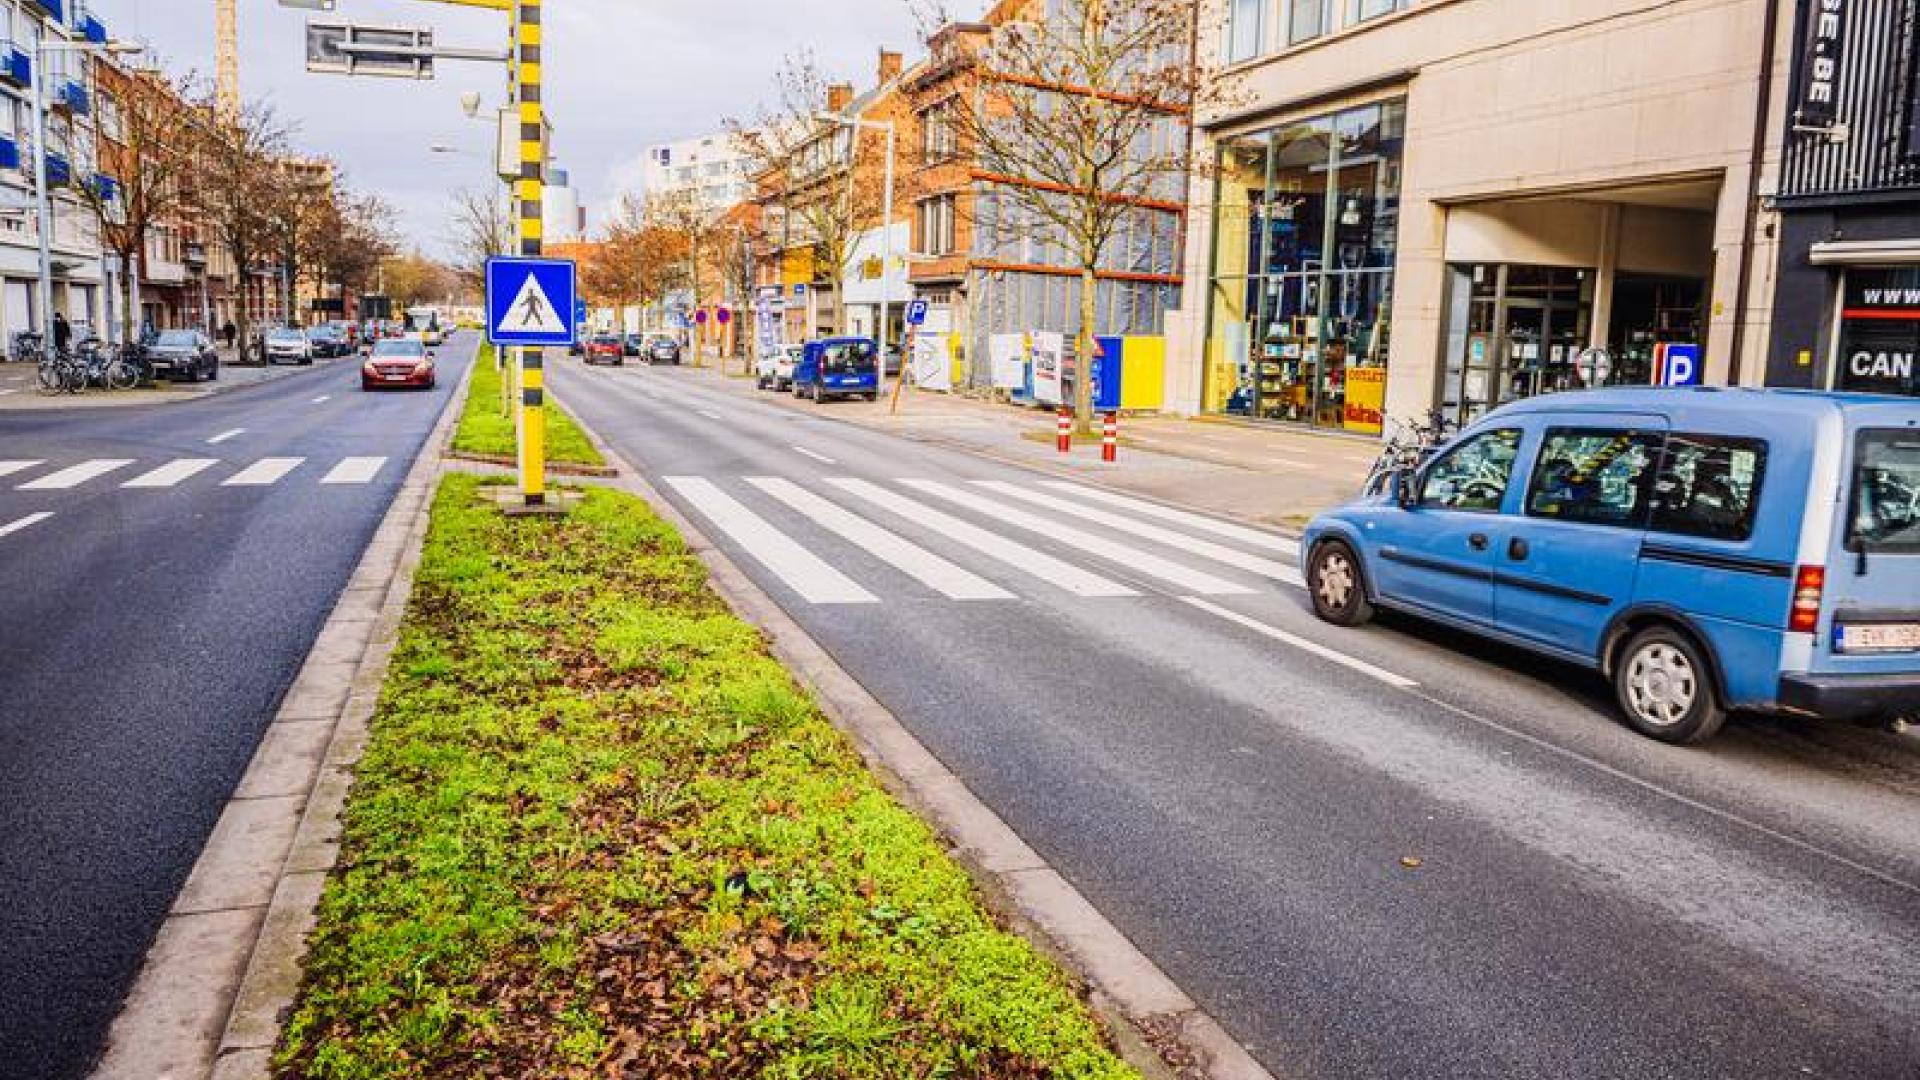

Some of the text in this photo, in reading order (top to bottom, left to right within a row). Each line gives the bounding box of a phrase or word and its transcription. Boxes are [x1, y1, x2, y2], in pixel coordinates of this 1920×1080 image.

[911, 302, 925, 319] P
[1669, 355, 1693, 387] P
[1850, 351, 1914, 378] CAN
